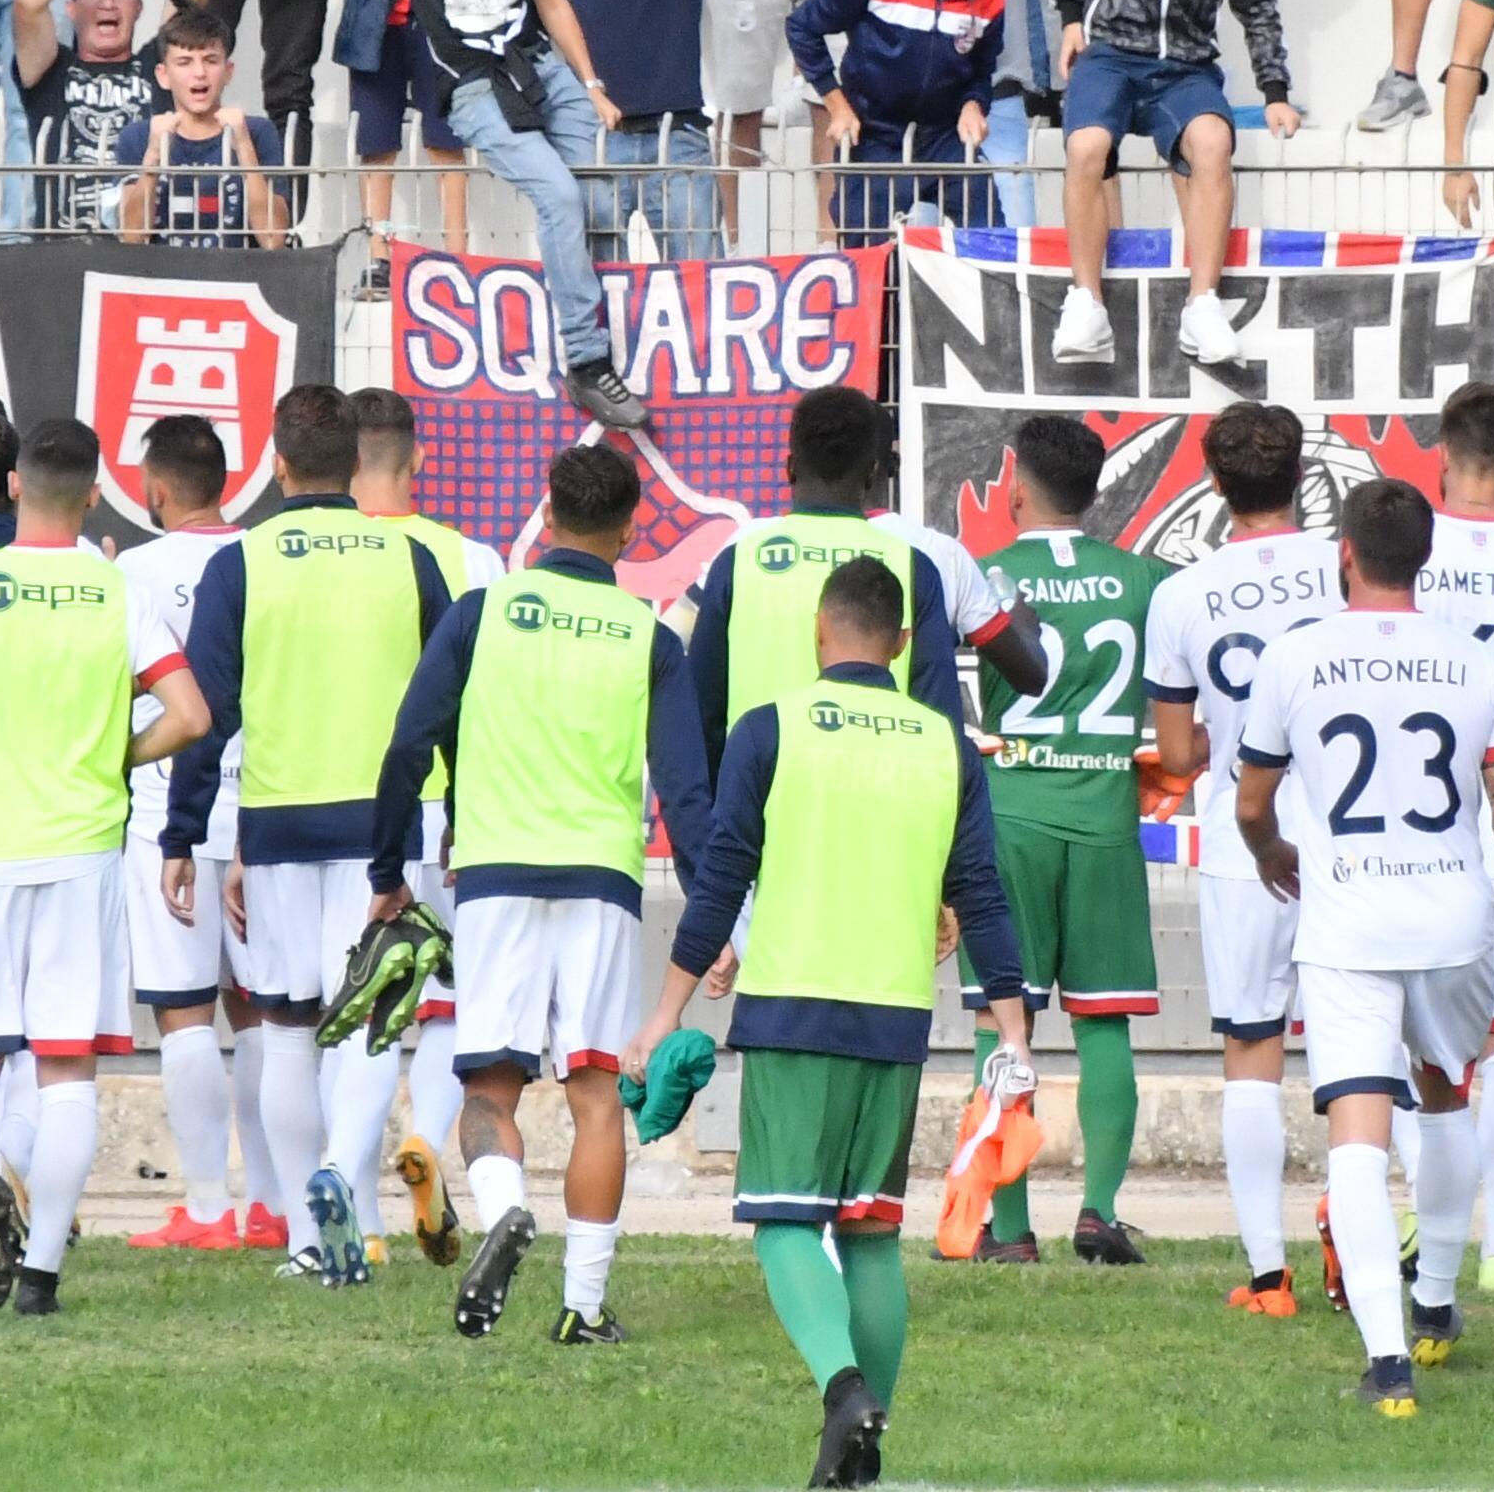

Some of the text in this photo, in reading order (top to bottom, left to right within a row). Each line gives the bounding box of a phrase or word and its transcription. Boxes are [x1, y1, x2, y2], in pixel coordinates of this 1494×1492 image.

[1018, 575, 1123, 604] SALVATO
[1206, 568, 1327, 621] ROSSI
[1000, 619, 1137, 735] 22
[1312, 658, 1466, 689] ANTONELLI
[1028, 744, 1132, 771] Character
[1318, 711, 1462, 837] 23
[1363, 855, 1466, 878] Character
